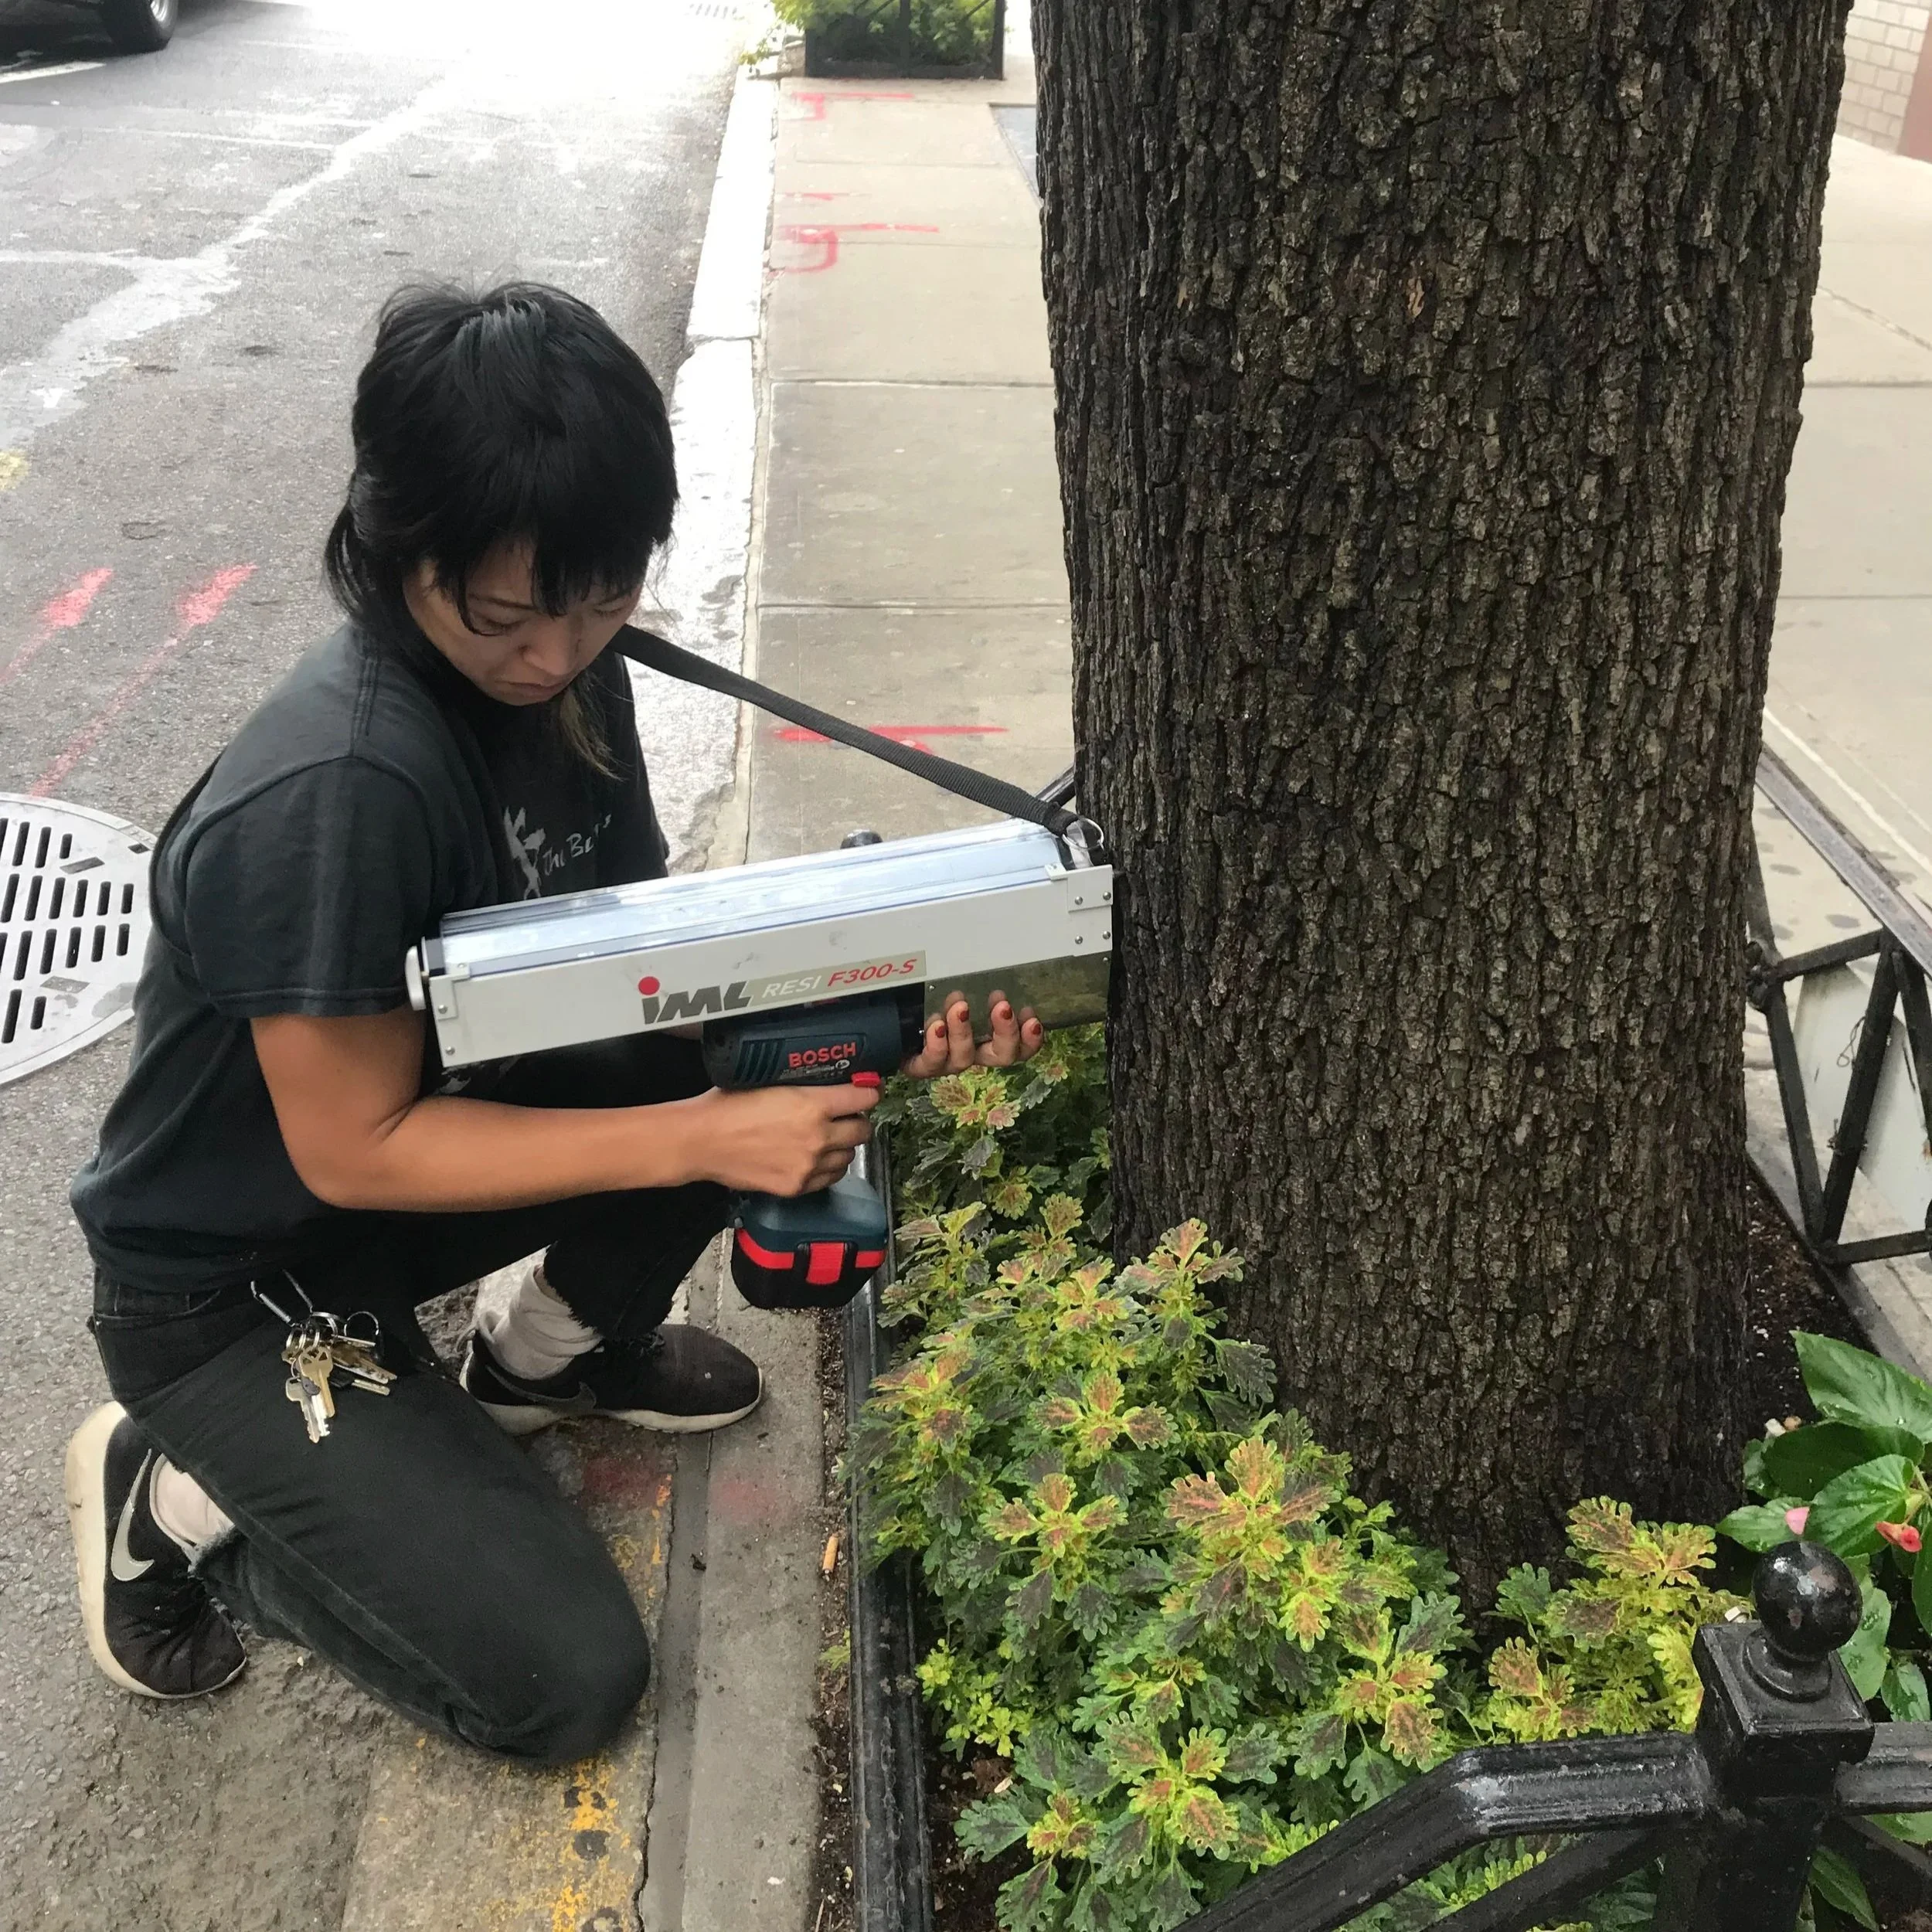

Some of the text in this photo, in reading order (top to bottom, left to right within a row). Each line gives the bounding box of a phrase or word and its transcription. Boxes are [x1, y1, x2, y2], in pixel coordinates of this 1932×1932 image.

[762, 976, 821, 999] RESI
[828, 958, 917, 987] F300-S
[788, 1041, 856, 1068] BOSCH
